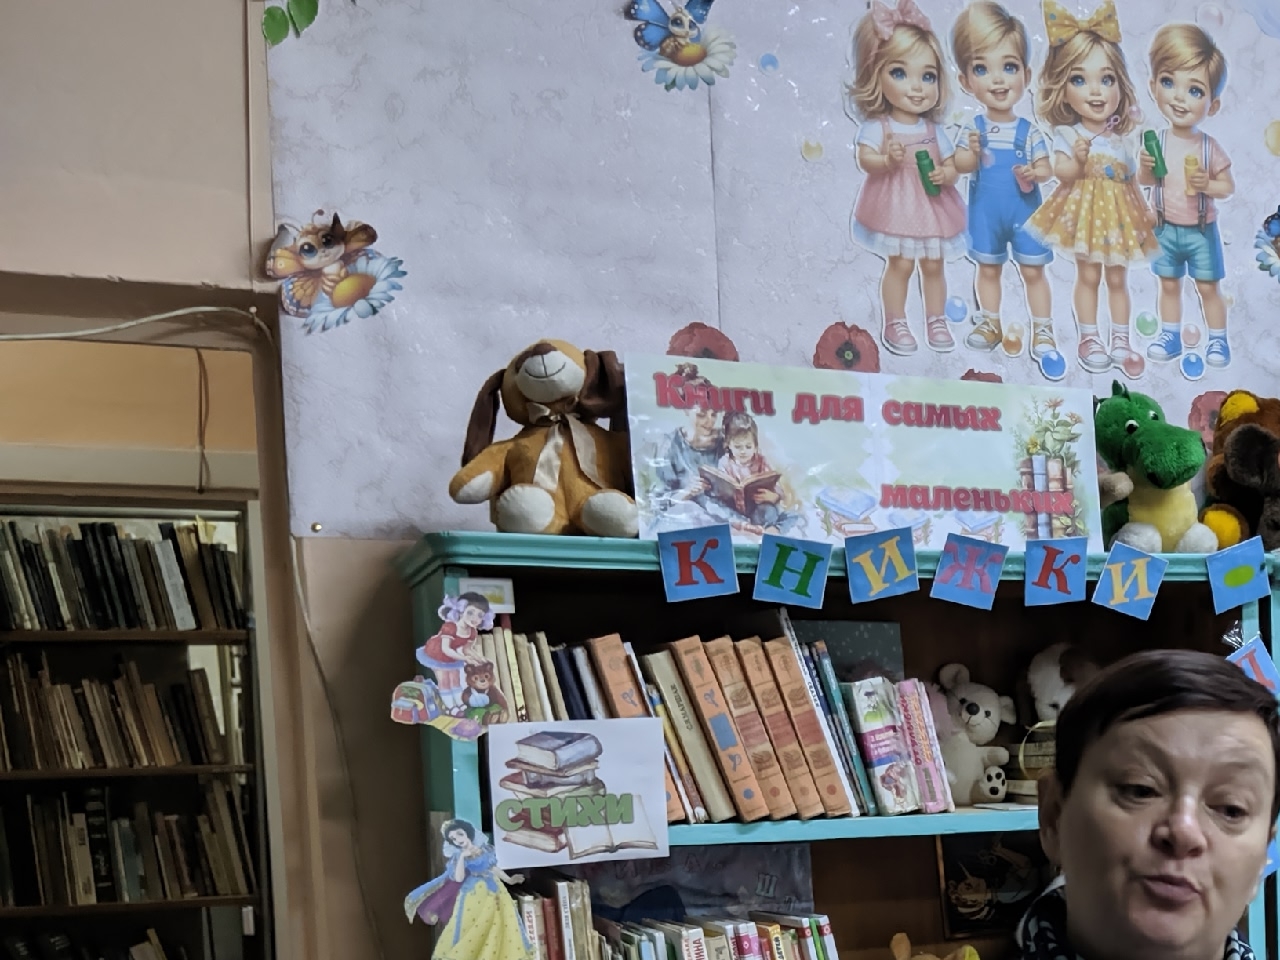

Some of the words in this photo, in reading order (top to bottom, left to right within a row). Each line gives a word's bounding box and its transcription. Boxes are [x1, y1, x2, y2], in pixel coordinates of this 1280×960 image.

[653, 372, 776, 417] Книги
[792, 391, 865, 424] для
[881, 398, 1003, 431] самых
[879, 484, 1076, 516] маленьких
[505, 793, 644, 831] СТИХИ
